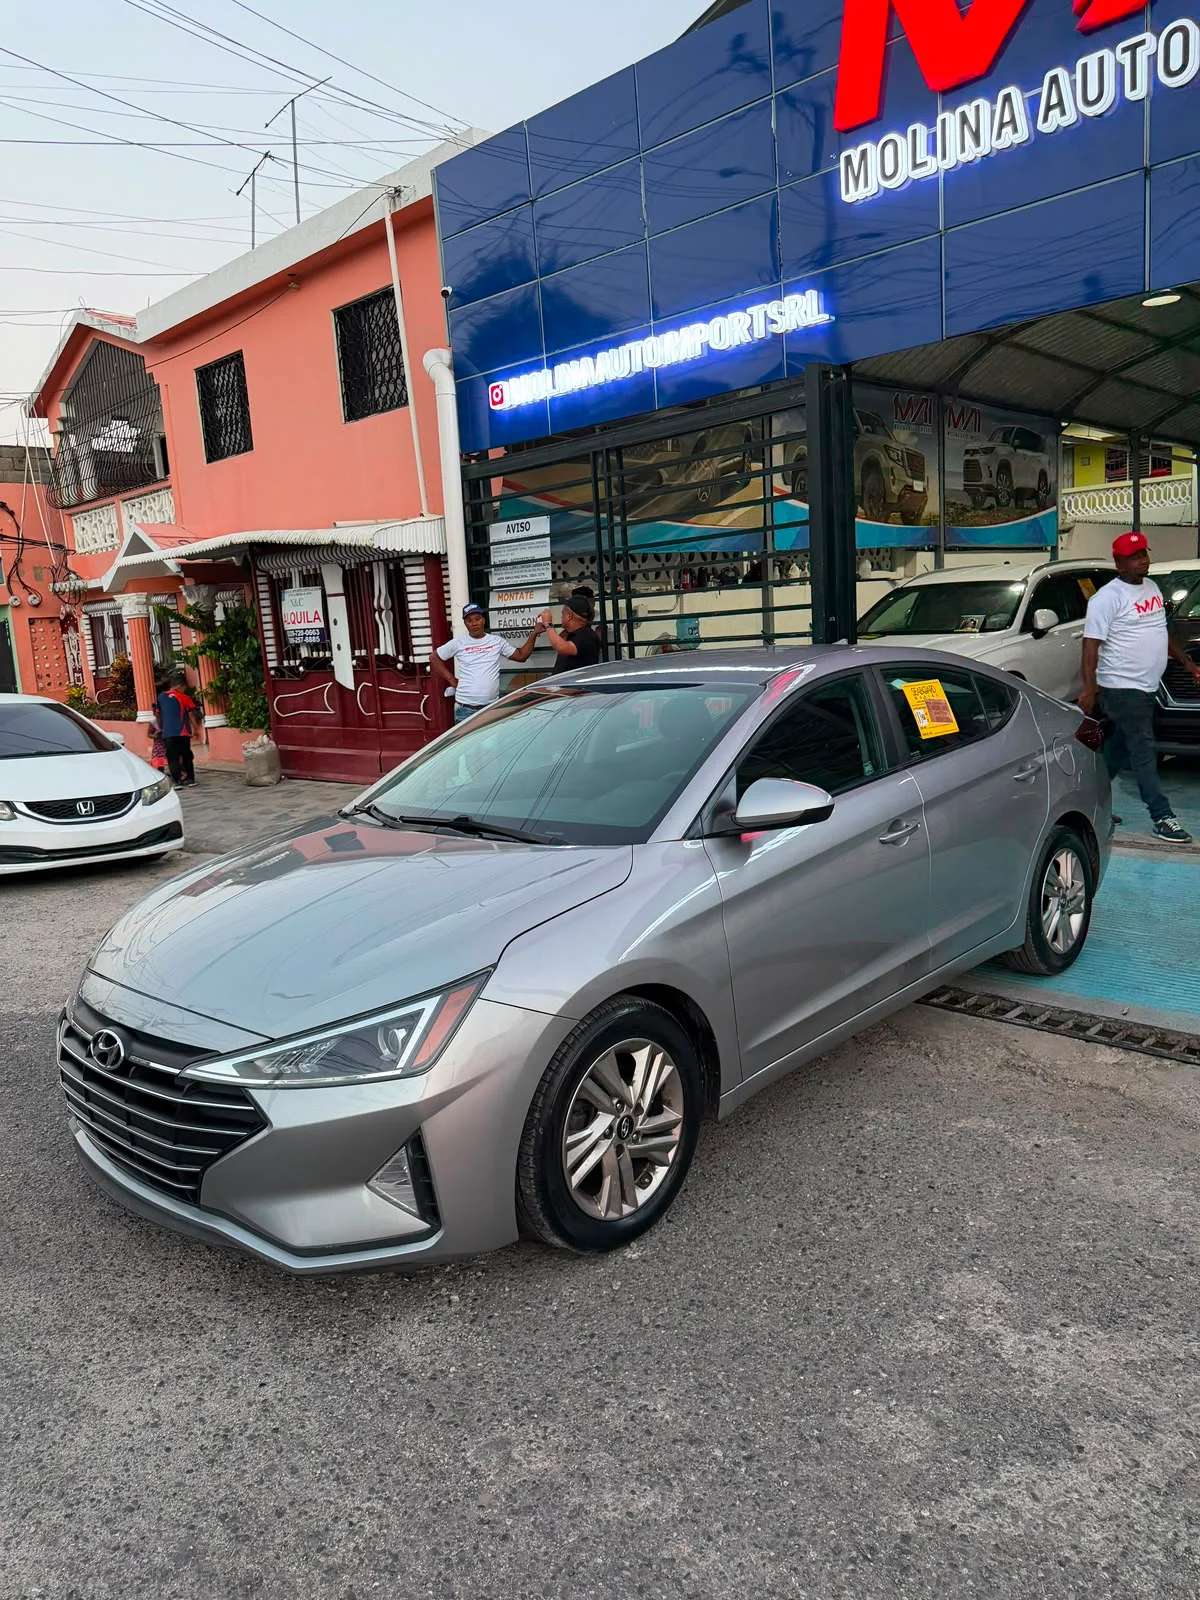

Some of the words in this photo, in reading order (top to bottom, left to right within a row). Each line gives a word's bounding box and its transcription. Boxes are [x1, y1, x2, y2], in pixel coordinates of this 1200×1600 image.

[840, 86, 1029, 203] MOLINA
[1036, 18, 1200, 134] AUTO
[506, 521, 531, 534] AVISO
[497, 616, 520, 628] FÁCIL
